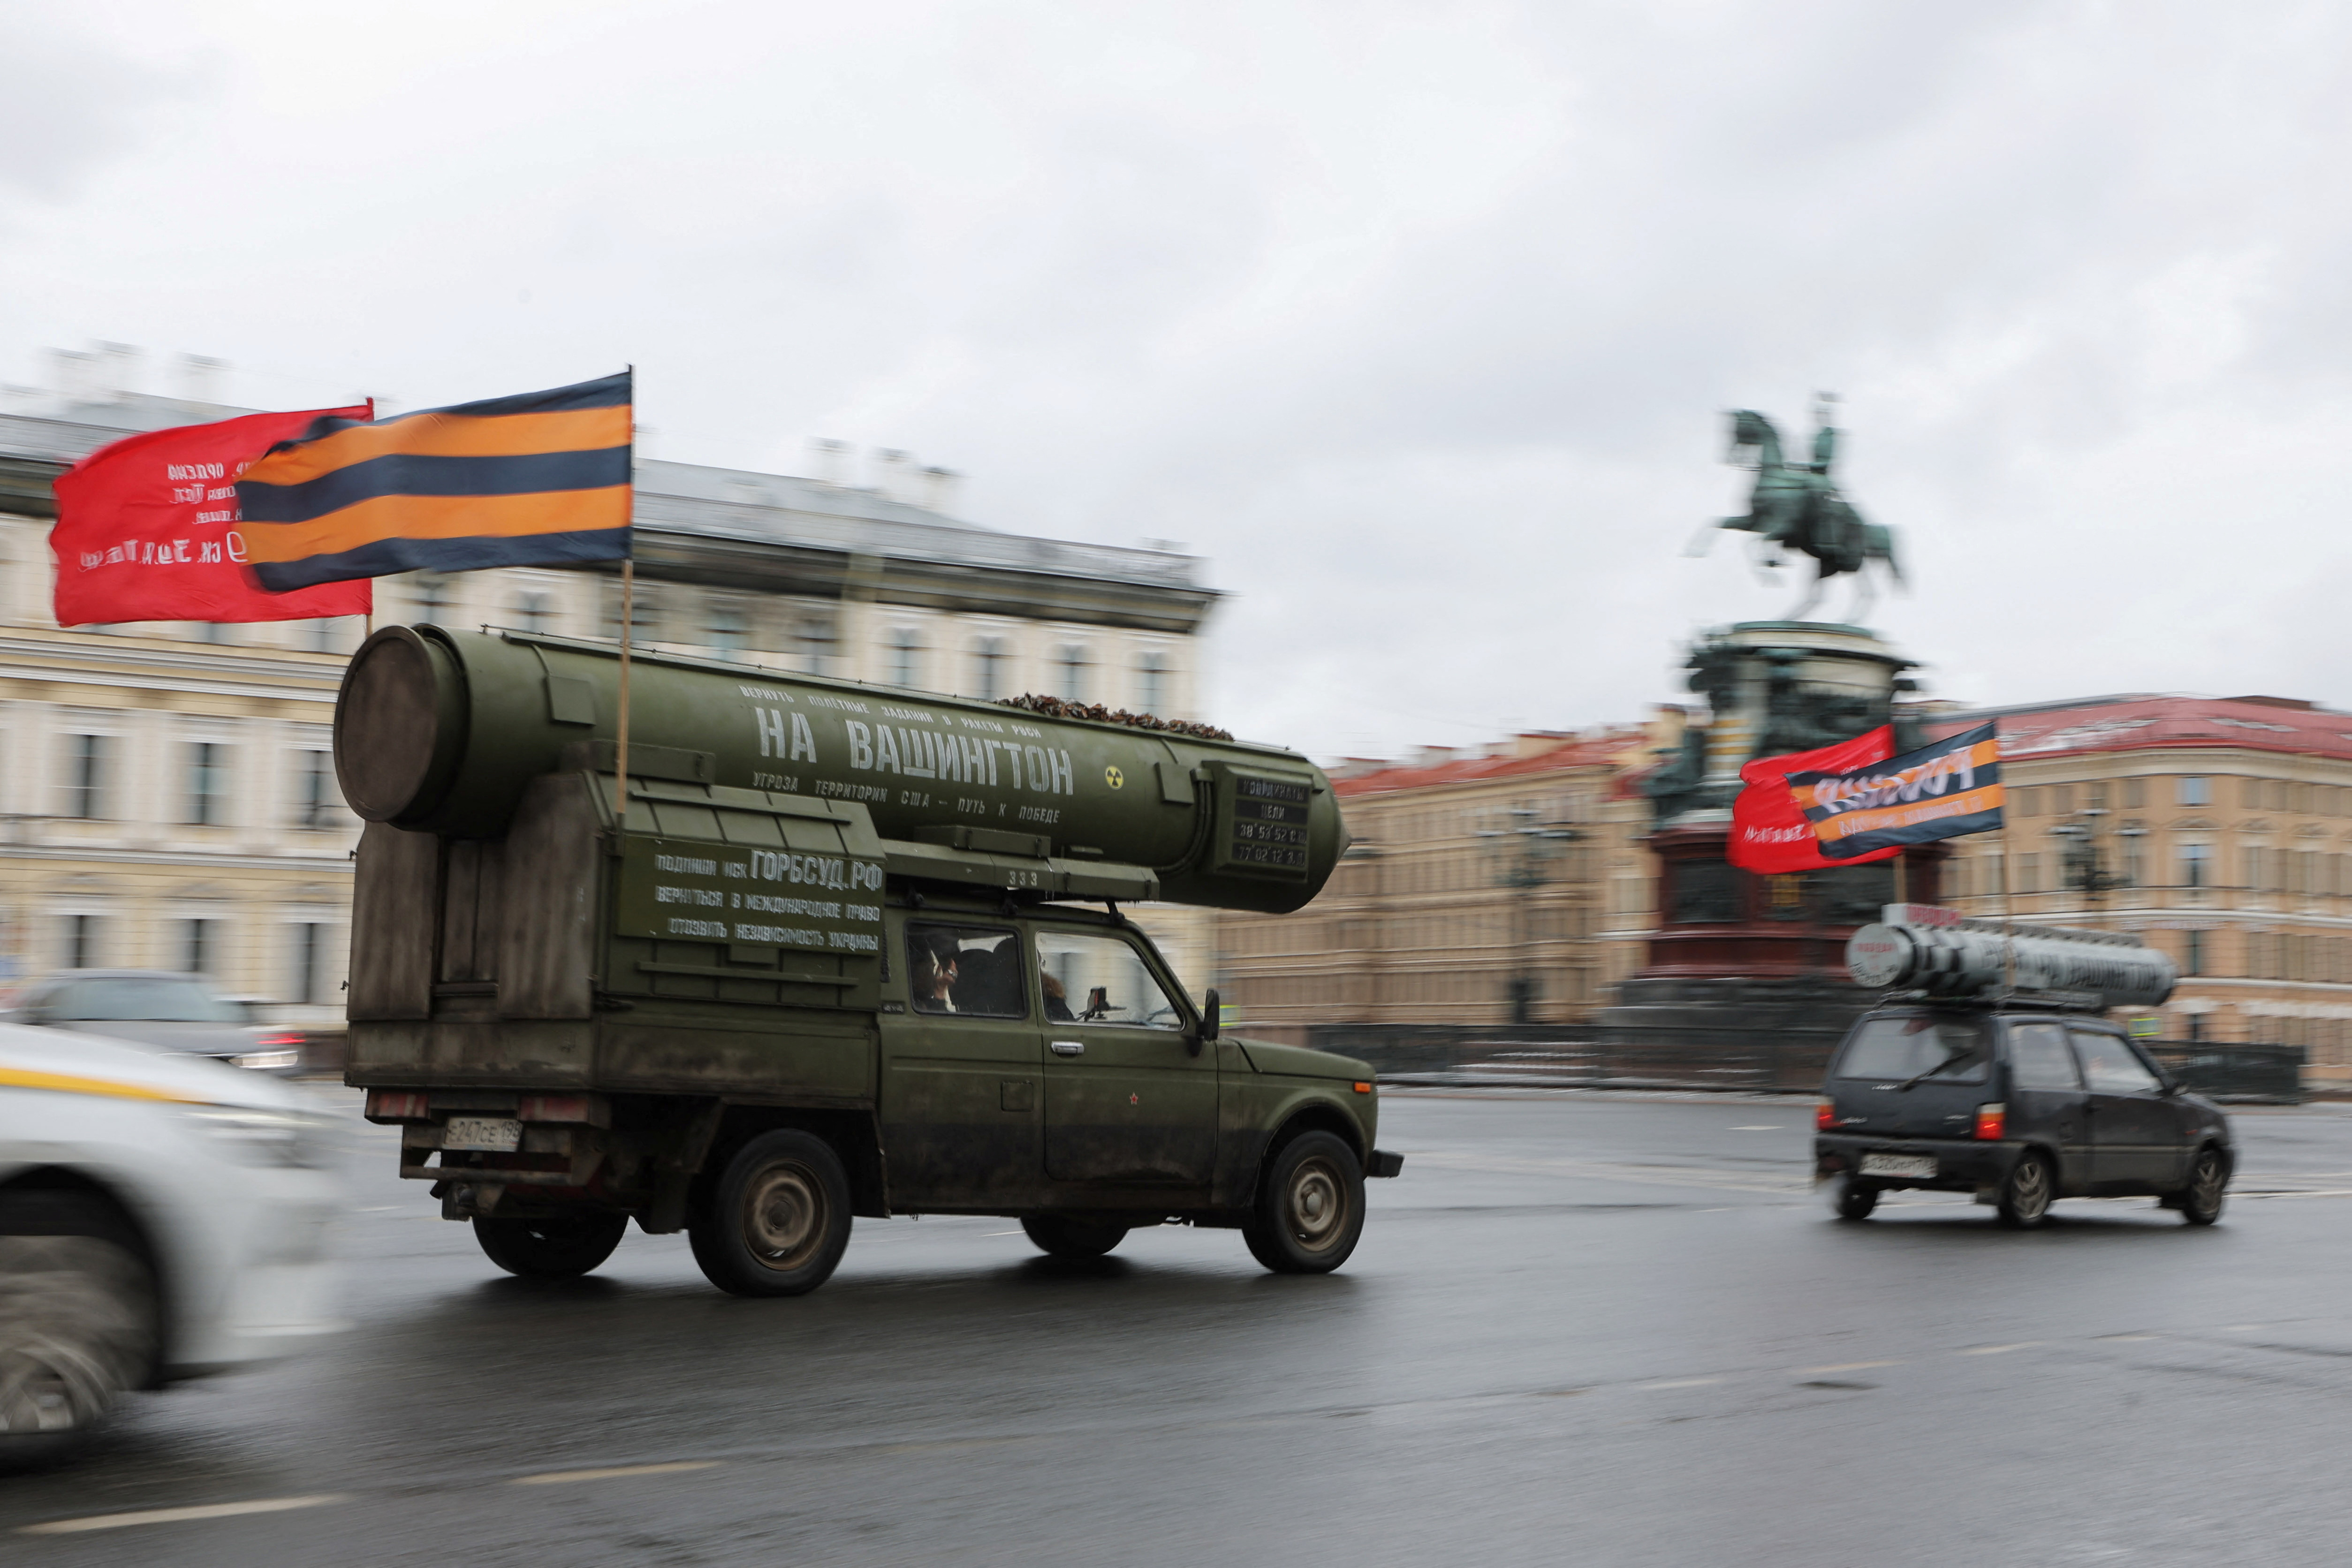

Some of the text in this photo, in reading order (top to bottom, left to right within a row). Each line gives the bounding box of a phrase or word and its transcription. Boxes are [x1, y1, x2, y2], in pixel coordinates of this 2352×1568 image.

[738, 685, 794, 703] ВЕРНУТЬ
[960, 717, 1003, 733] РАКЕТЫ
[755, 707, 1073, 795] НА ВАШИНГТОН
[752, 771, 798, 791] УГРОЗА
[815, 779, 888, 803] ТЕРРИТОРИИ
[900, 790, 930, 807] США
[958, 797, 985, 814] ПУТЬ
[998, 803, 1007, 817] К
[1019, 805, 1060, 824] ПОБЕДЕ
[1261, 804, 1285, 820] ЦЕЛИ
[655, 849, 882, 891] ПОДПИШИ ИСК ГОРБСУД.РФ
[655, 885, 880, 921] ВЕРНУТЬСЯ В МЕЖДУНАРОДНОЕ ПРАВО
[668, 917, 878, 951] ОТОЗВАТЬ НЕЗАВИСИМОСТЬ УКРАИНЫ
